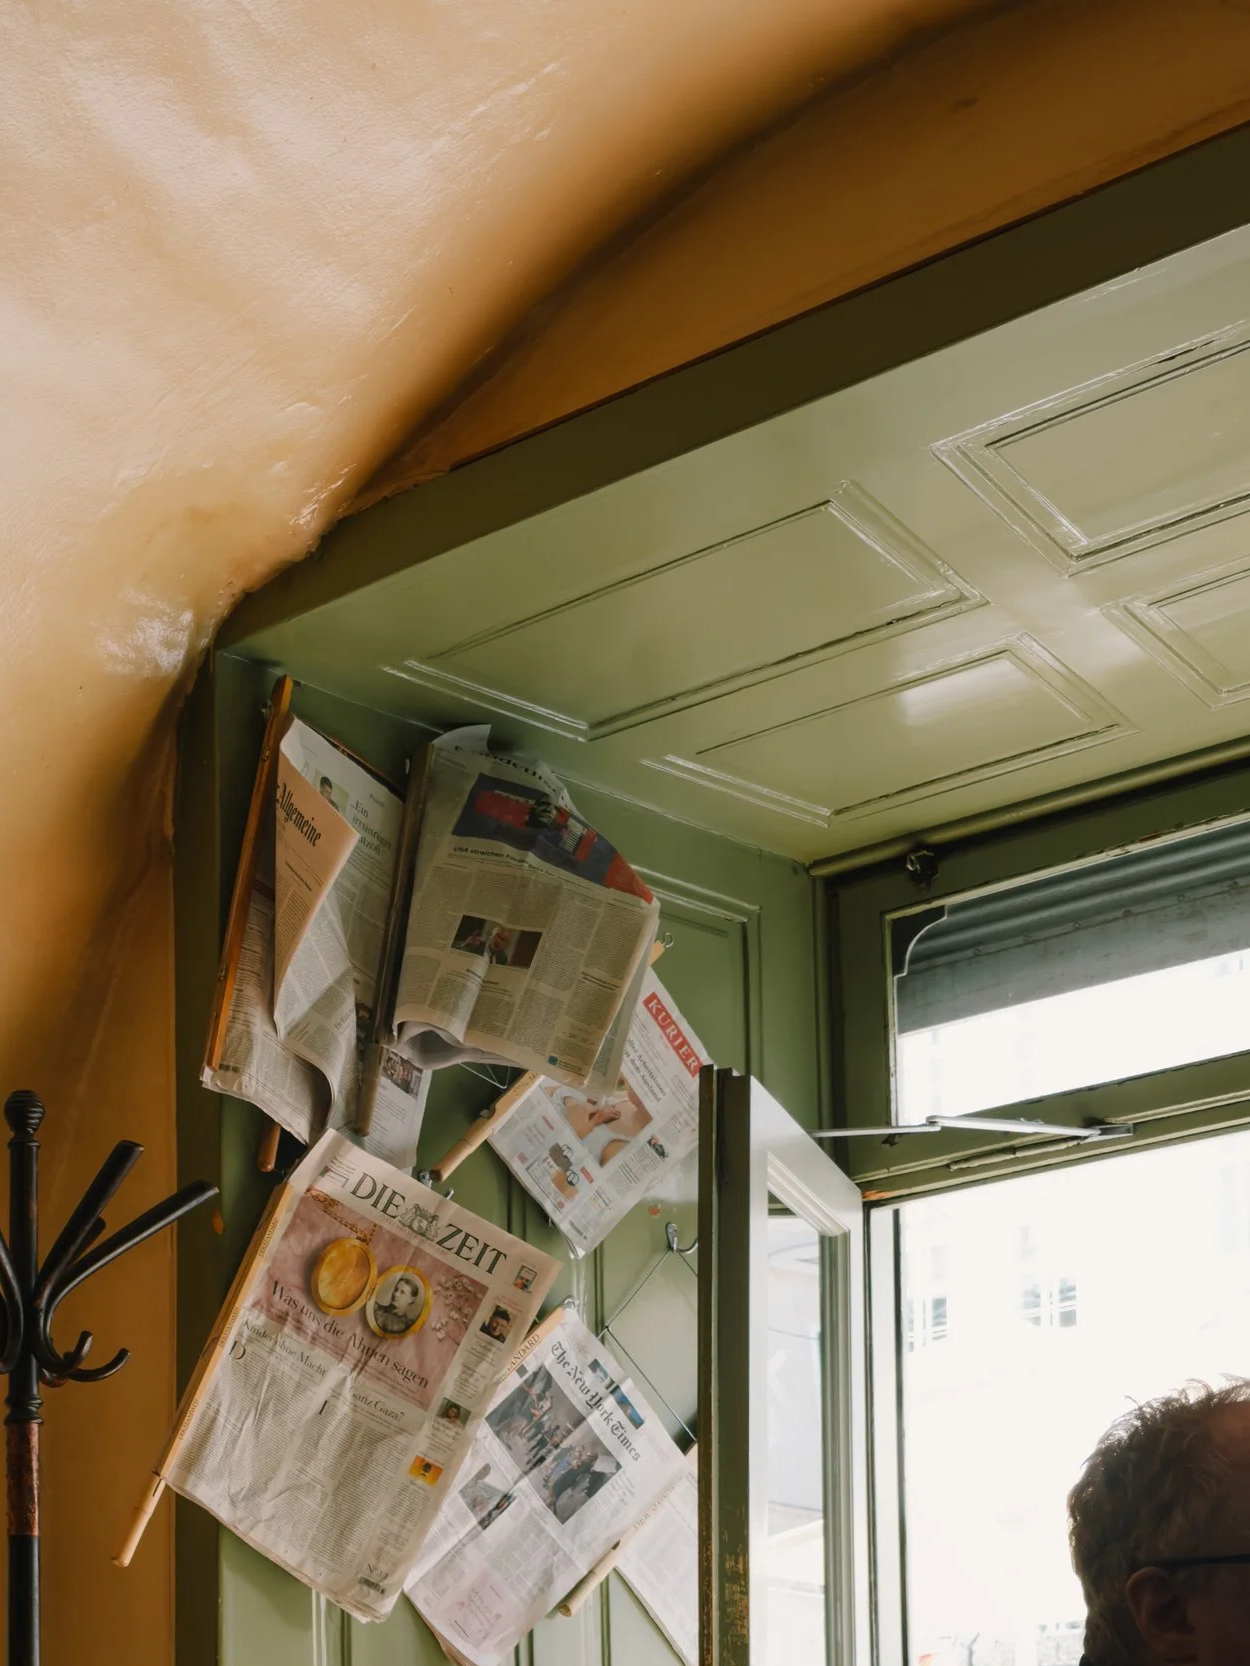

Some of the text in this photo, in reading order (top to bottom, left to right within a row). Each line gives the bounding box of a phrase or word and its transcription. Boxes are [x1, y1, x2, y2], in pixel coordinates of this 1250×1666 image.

[278, 782, 322, 847] Allgemeine
[648, 999, 700, 1072] KURIER
[349, 1172, 406, 1219] DIE
[436, 1223, 508, 1276] ZEIT
[244, 1318, 275, 1343] Kinder
[299, 1351, 326, 1377] Macht
[272, 1280, 299, 1310] Was
[300, 1305, 322, 1326] uns
[323, 1318, 345, 1338] die
[392, 1360, 430, 1389] sagen
[507, 1334, 540, 1371] ANDARD
[551, 1341, 570, 1372] The
[567, 1365, 591, 1396] New
[585, 1391, 614, 1428] York
[610, 1420, 641, 1461] Times
